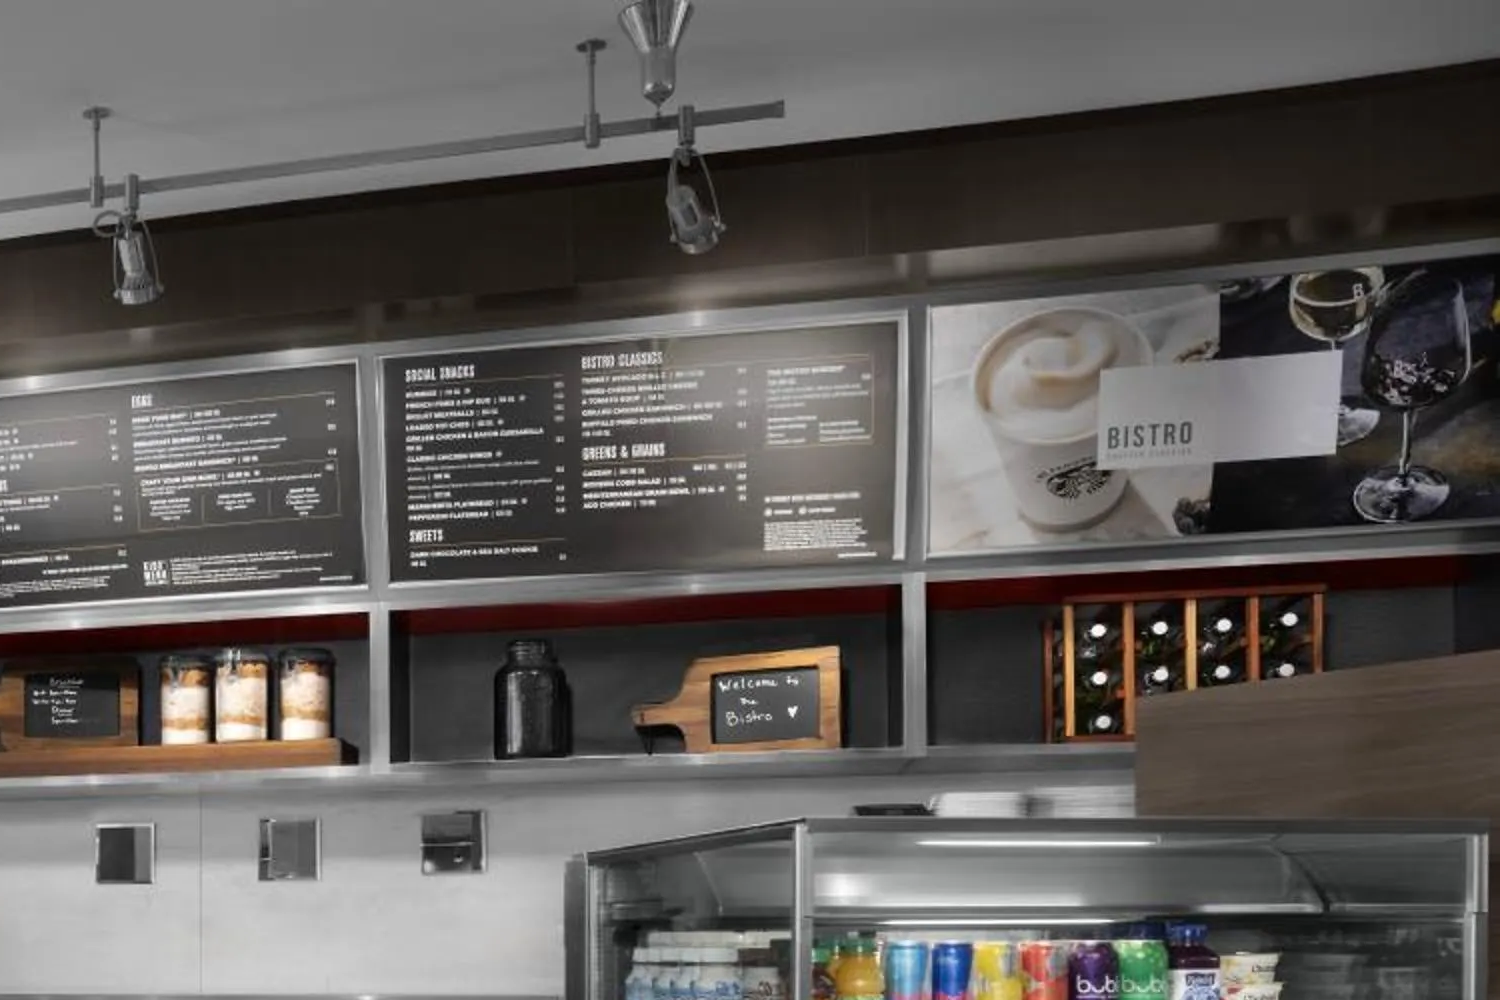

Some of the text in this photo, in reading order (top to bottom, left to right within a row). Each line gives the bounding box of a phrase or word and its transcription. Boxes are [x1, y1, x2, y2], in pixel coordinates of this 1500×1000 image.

[581, 351, 664, 369] BISTRO CLASSICS
[405, 364, 475, 383] SOCIAL SNACKS
[1107, 421, 1193, 450] BISTRO
[581, 444, 617, 461] GREENS
[619, 444, 629, 459] &
[409, 529, 444, 542] SWEETS
[718, 675, 800, 693] Welcome to
[725, 711, 773, 727] Bistro
[1076, 975, 1118, 994] bub
[1121, 975, 1164, 994] bub
